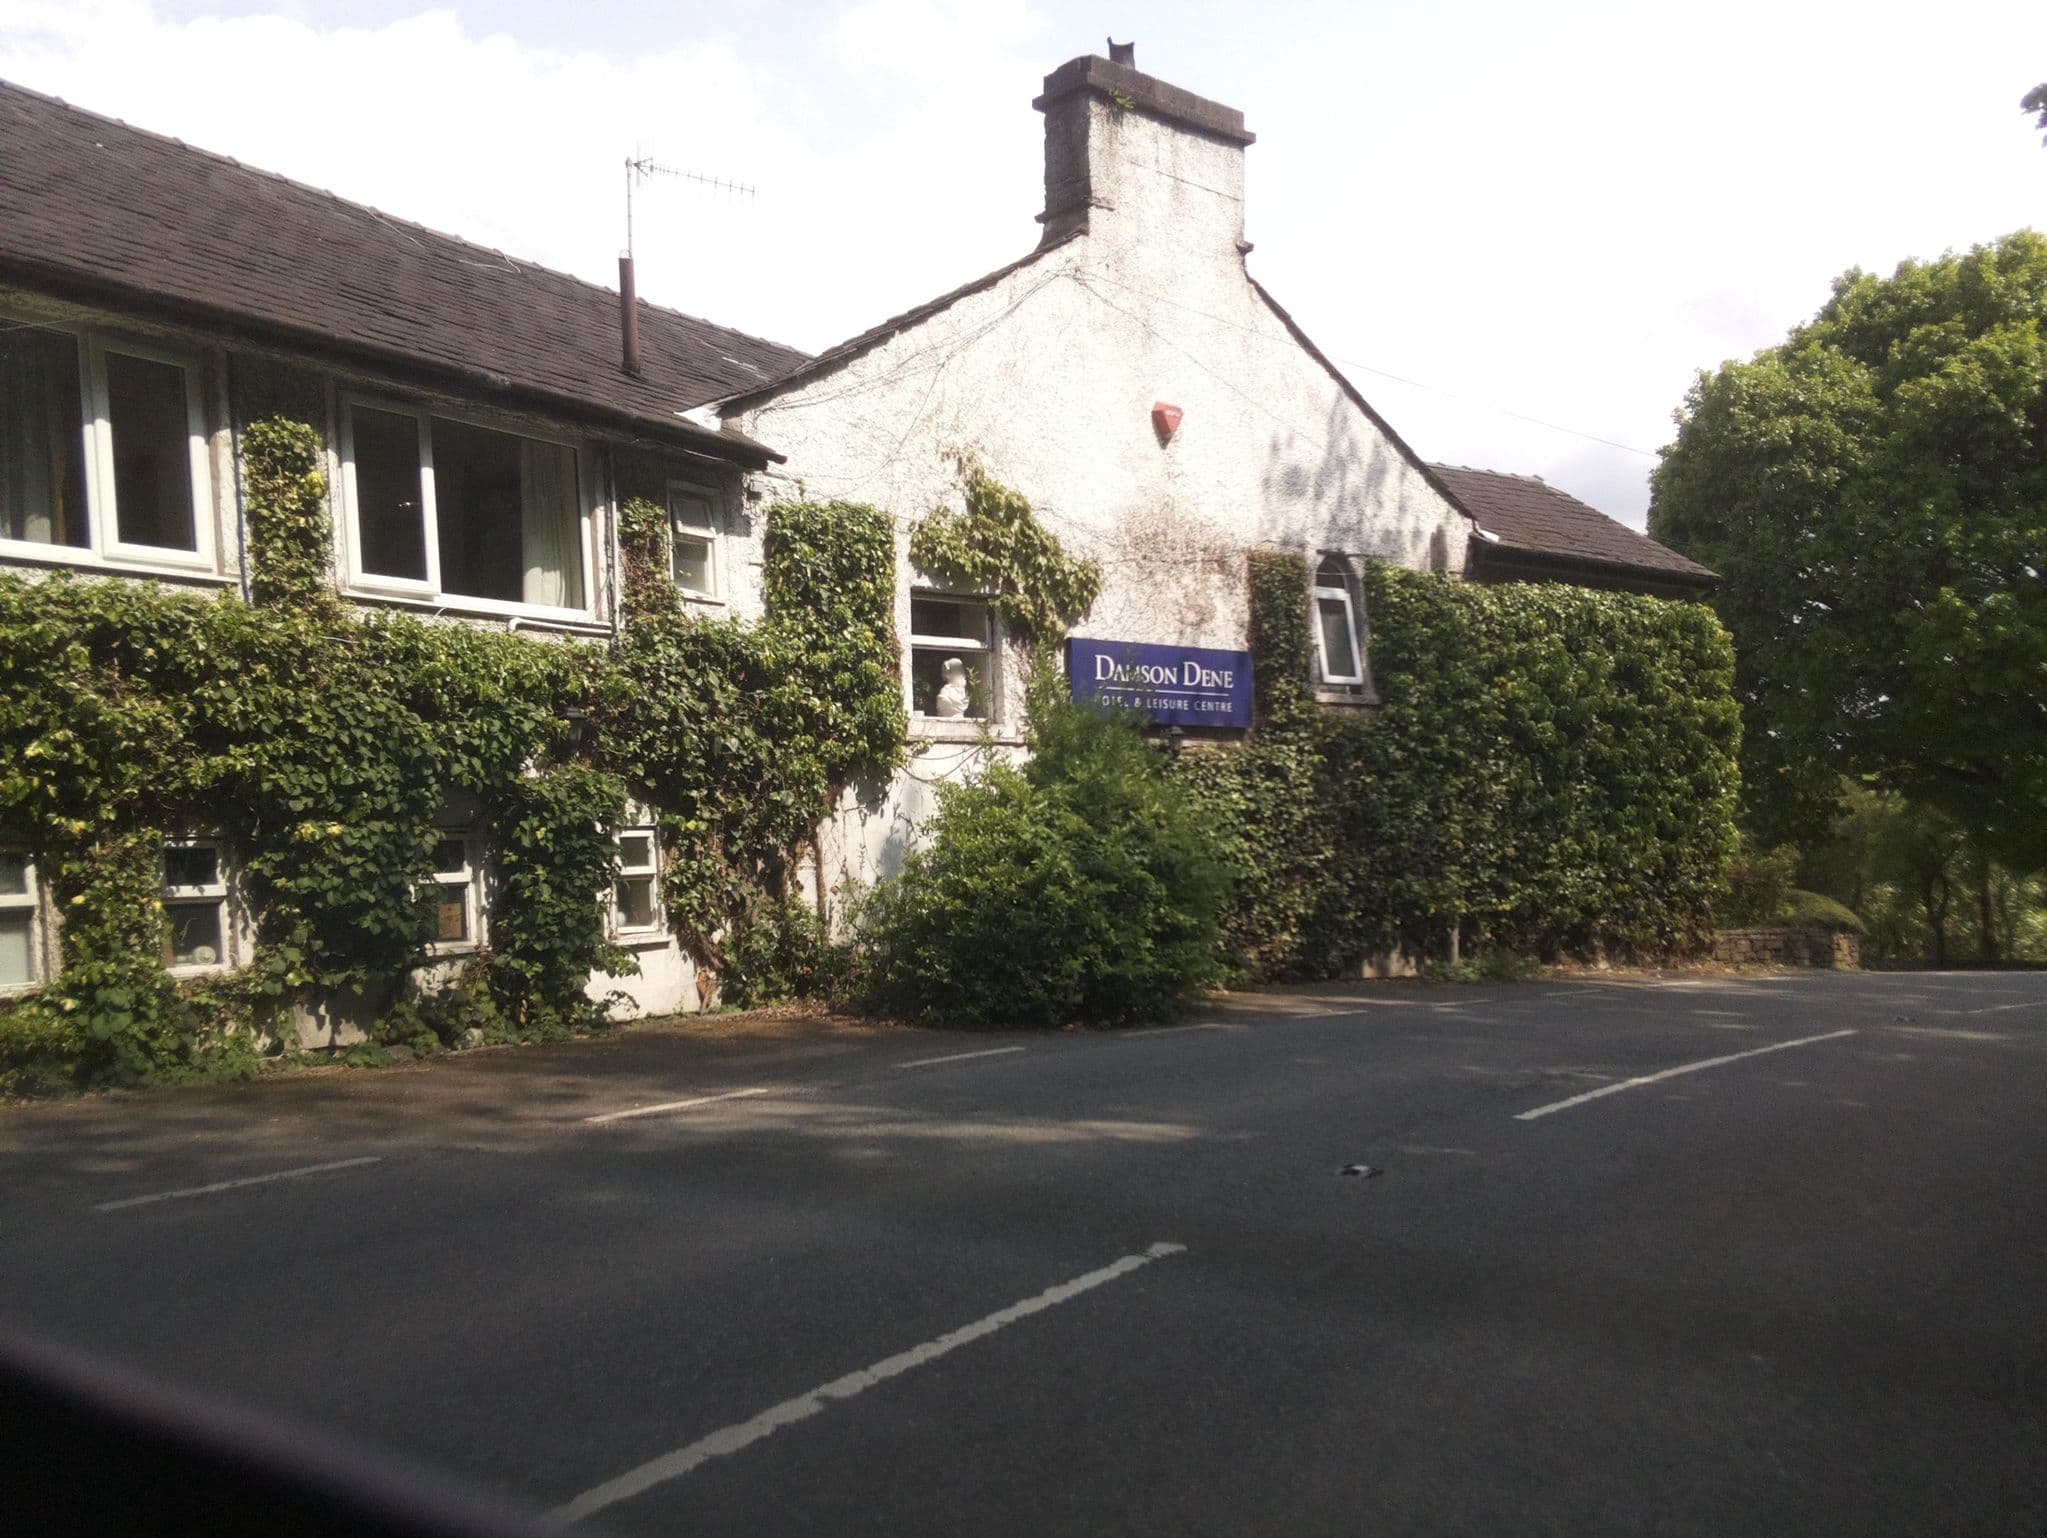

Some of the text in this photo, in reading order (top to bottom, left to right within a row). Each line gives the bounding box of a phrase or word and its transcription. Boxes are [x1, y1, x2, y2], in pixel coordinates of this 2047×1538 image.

[1184, 661, 1234, 688] DENE
[1097, 695, 1233, 712] OTE & LEISURE CENTRE
